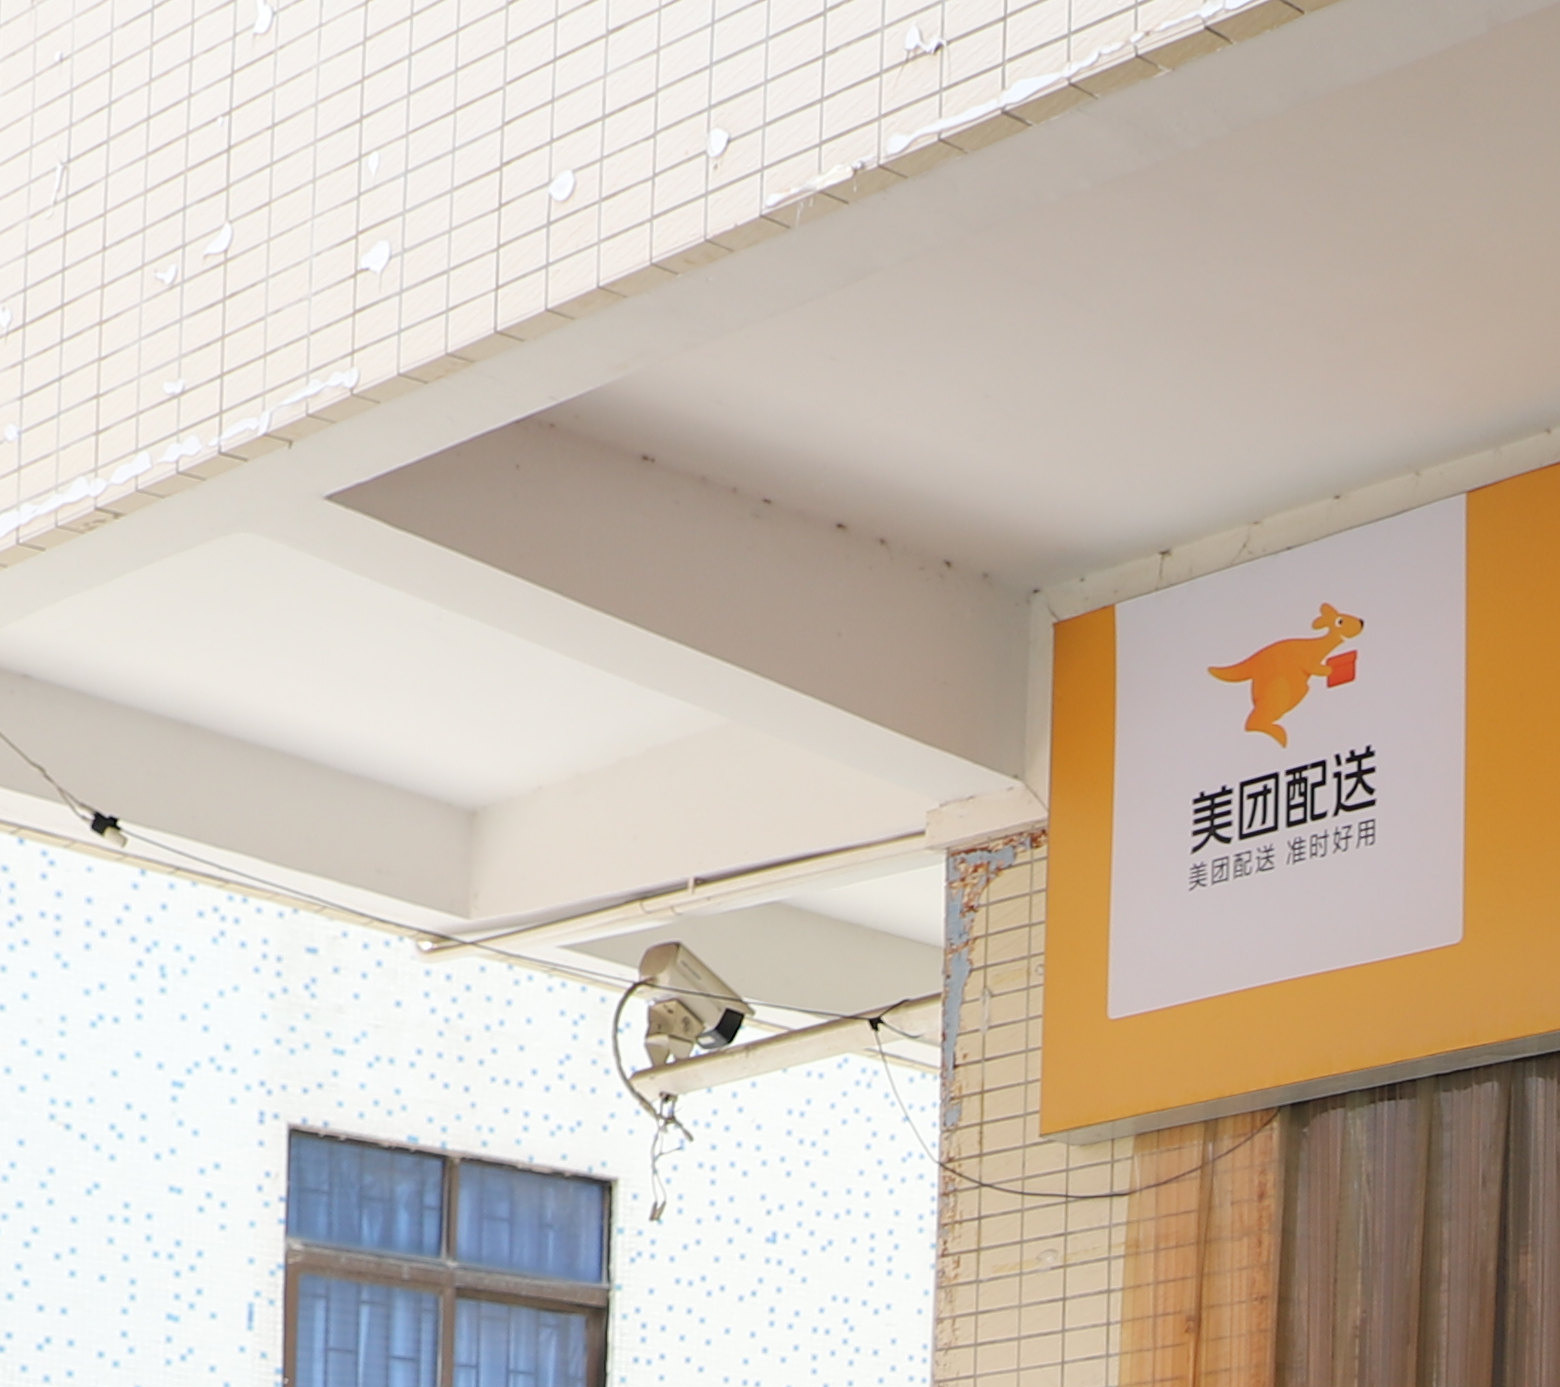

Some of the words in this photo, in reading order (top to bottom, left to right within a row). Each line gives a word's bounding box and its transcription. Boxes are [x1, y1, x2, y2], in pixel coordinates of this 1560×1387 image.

[1191, 744, 1377, 854] 美团配送
[1188, 844, 1276, 891] 美团配送
[1285, 817, 1377, 865] 准时好用
